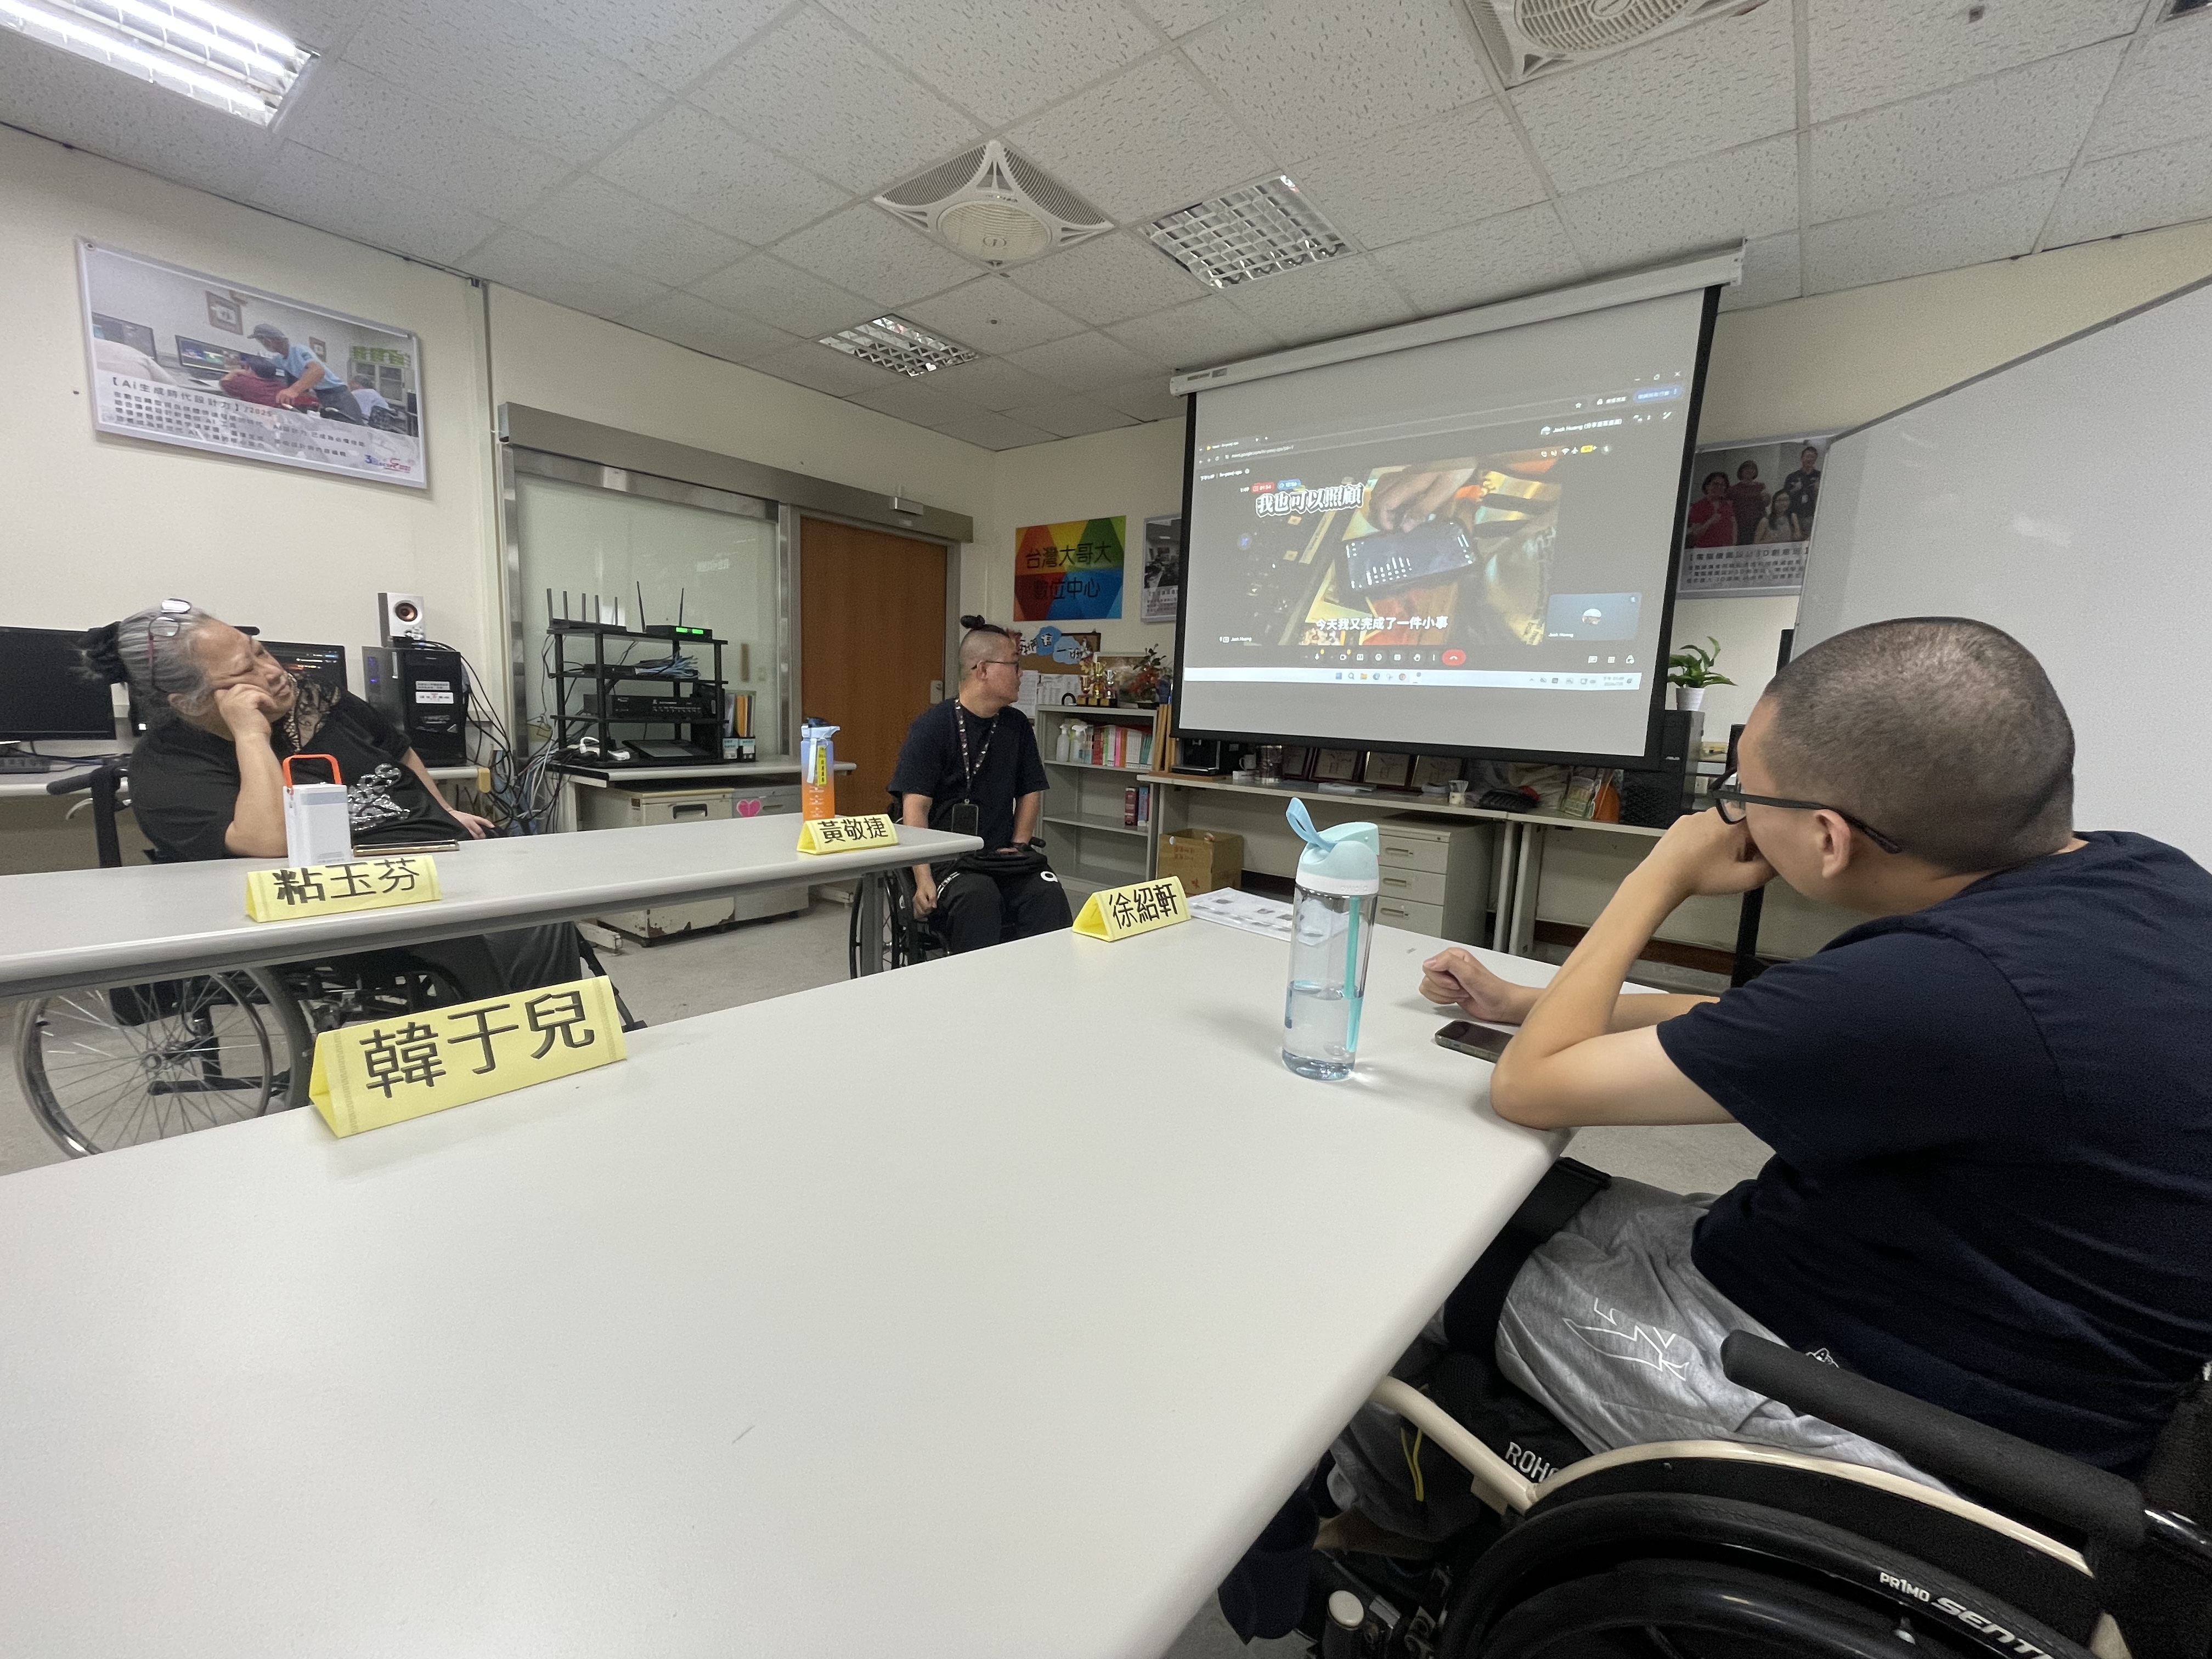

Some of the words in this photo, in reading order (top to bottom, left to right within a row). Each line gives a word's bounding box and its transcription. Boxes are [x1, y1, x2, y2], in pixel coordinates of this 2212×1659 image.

[1256, 483, 1364, 517] 我也可以照顧
[1025, 541, 1112, 569] 台灣大哥大
[1316, 616, 1448, 630] 今天我又完成了一件小事
[817, 817, 889, 843] 黃敬捷
[272, 857, 420, 905] 粘玉芬
[1109, 883, 1179, 929] 徐紹軒
[359, 990, 595, 1098] 韓于兒
